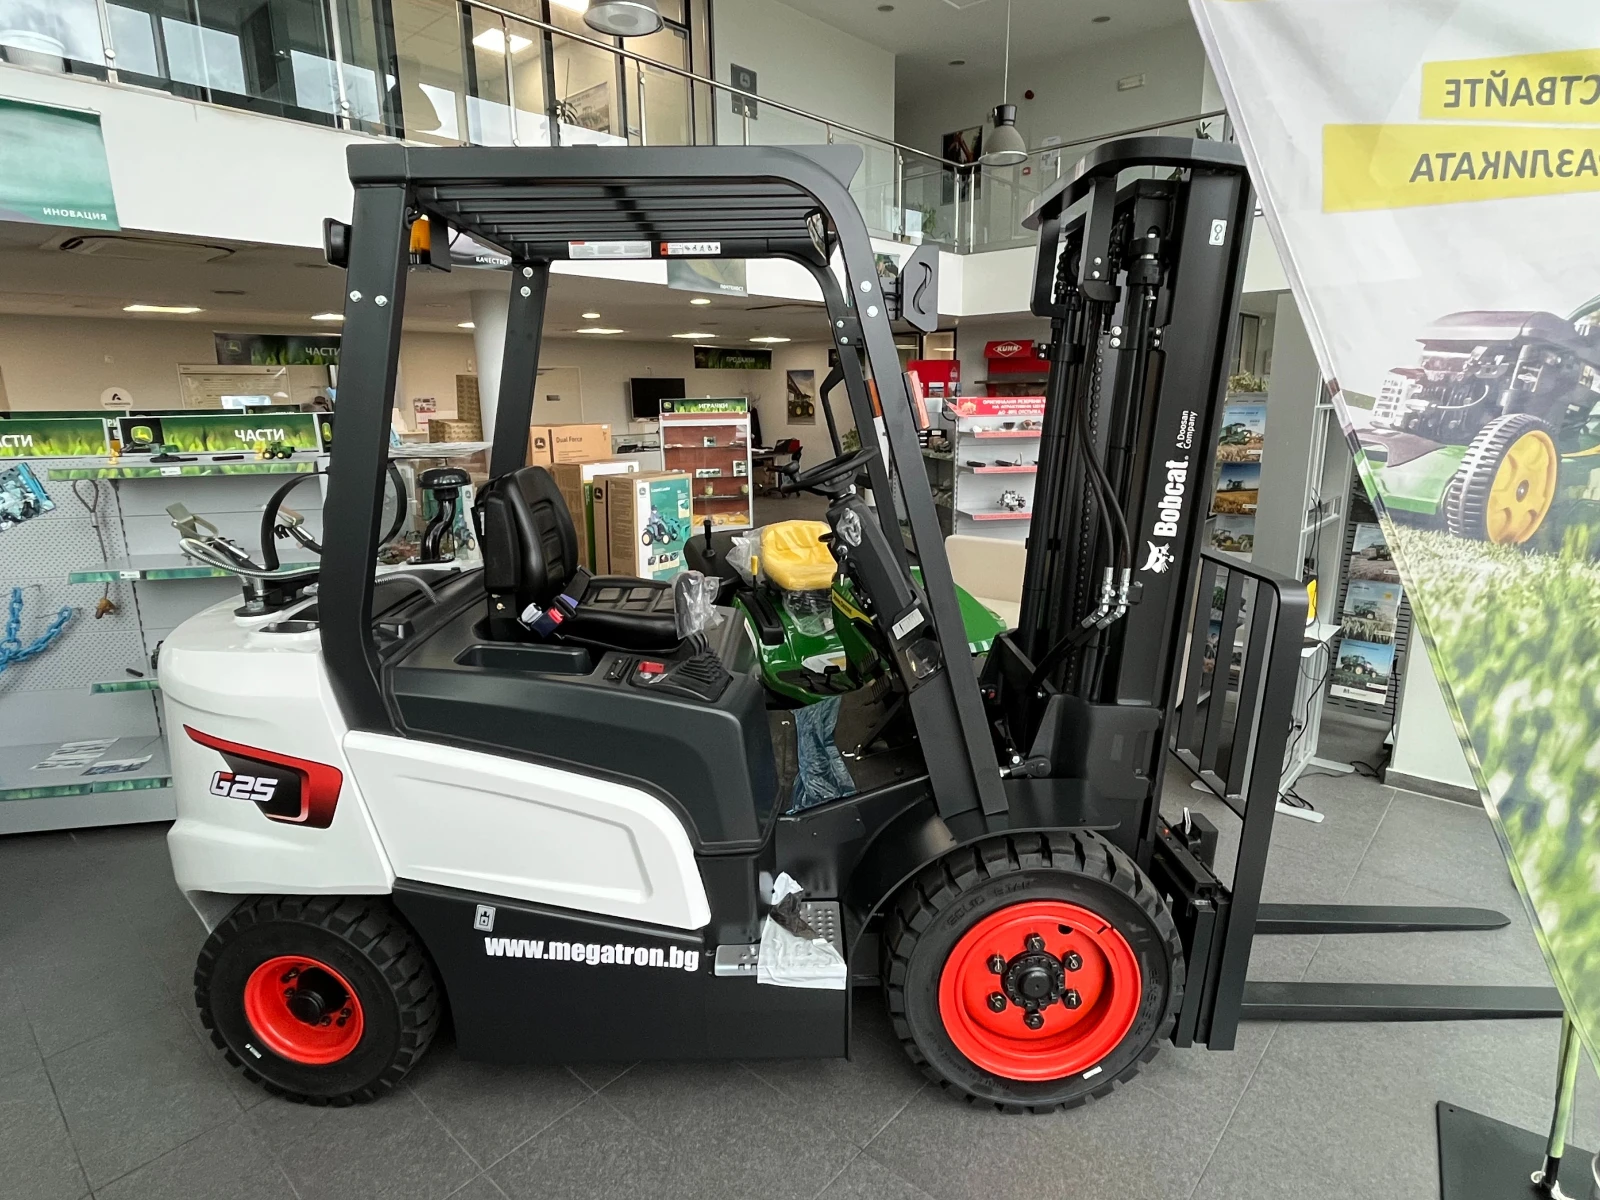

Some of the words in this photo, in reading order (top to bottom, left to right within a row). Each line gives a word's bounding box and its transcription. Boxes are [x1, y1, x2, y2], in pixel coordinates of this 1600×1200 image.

[43, 207, 108, 221] ИНОВАЦИЯ
[234, 428, 285, 442] ЧАСТИ
[1177, 410, 1189, 440] Doosan
[1183, 411, 1198, 449] Company
[0, 434, 33, 448] СТИ
[1175, 441, 1184, 449] A
[210, 771, 278, 802] G25
[484, 937, 700, 972] www.megatron.bg
